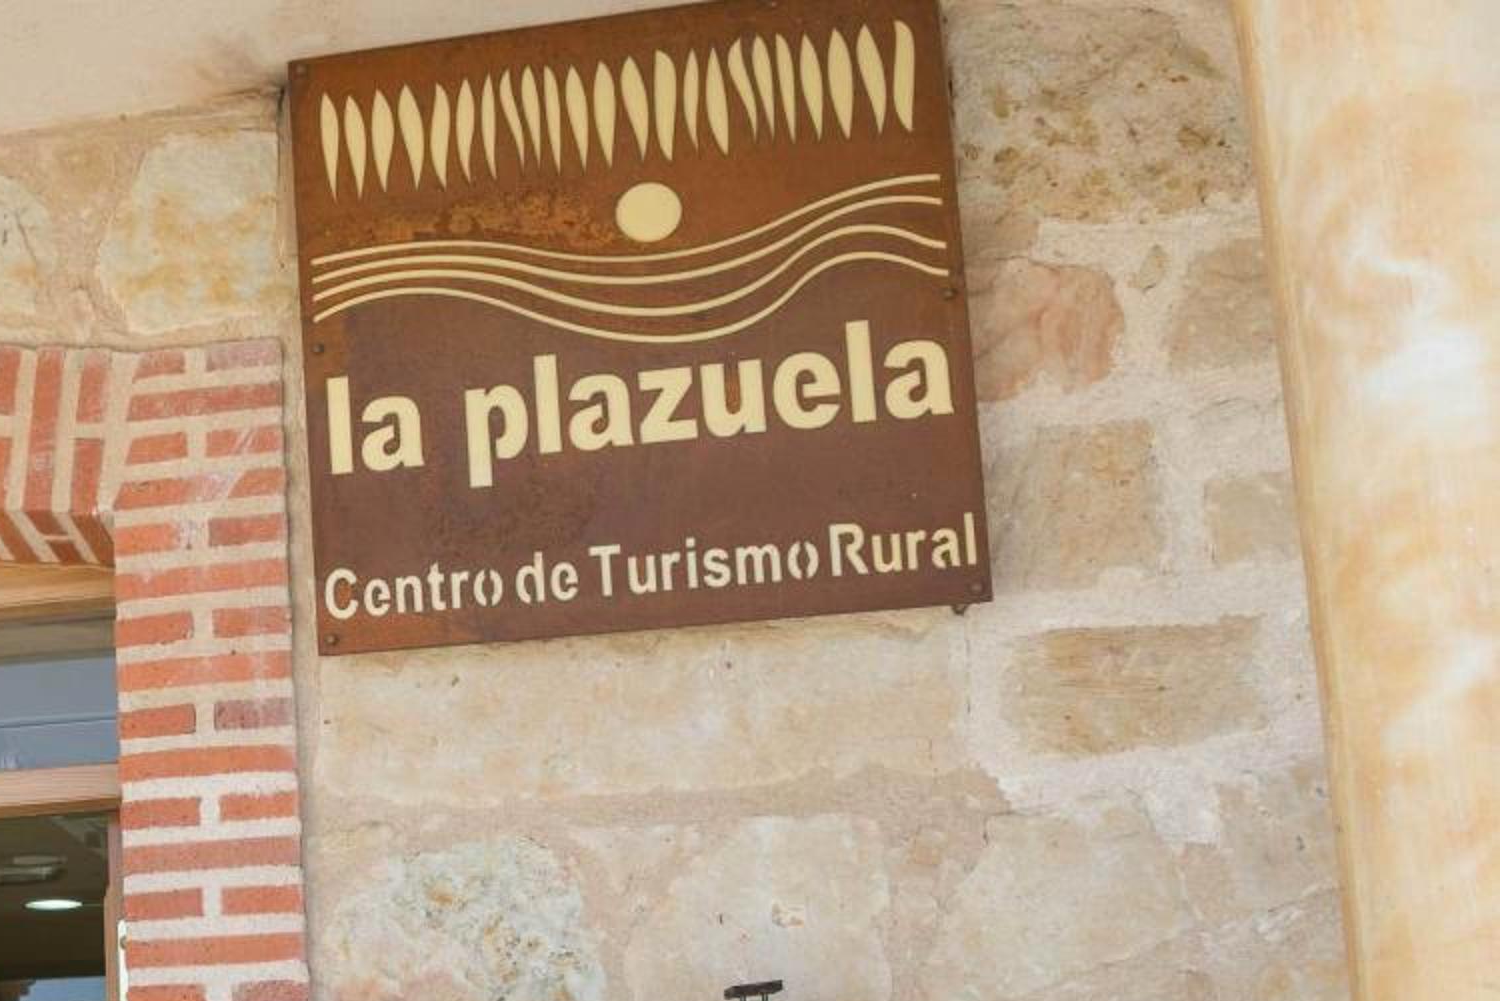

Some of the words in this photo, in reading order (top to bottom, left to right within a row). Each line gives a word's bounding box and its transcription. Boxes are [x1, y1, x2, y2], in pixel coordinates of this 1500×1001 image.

[326, 375, 425, 475] la
[463, 319, 954, 489] plazuela
[324, 560, 504, 620] Centro
[515, 550, 579, 604] de
[590, 537, 820, 596] Turismo
[828, 511, 979, 578] Rural
